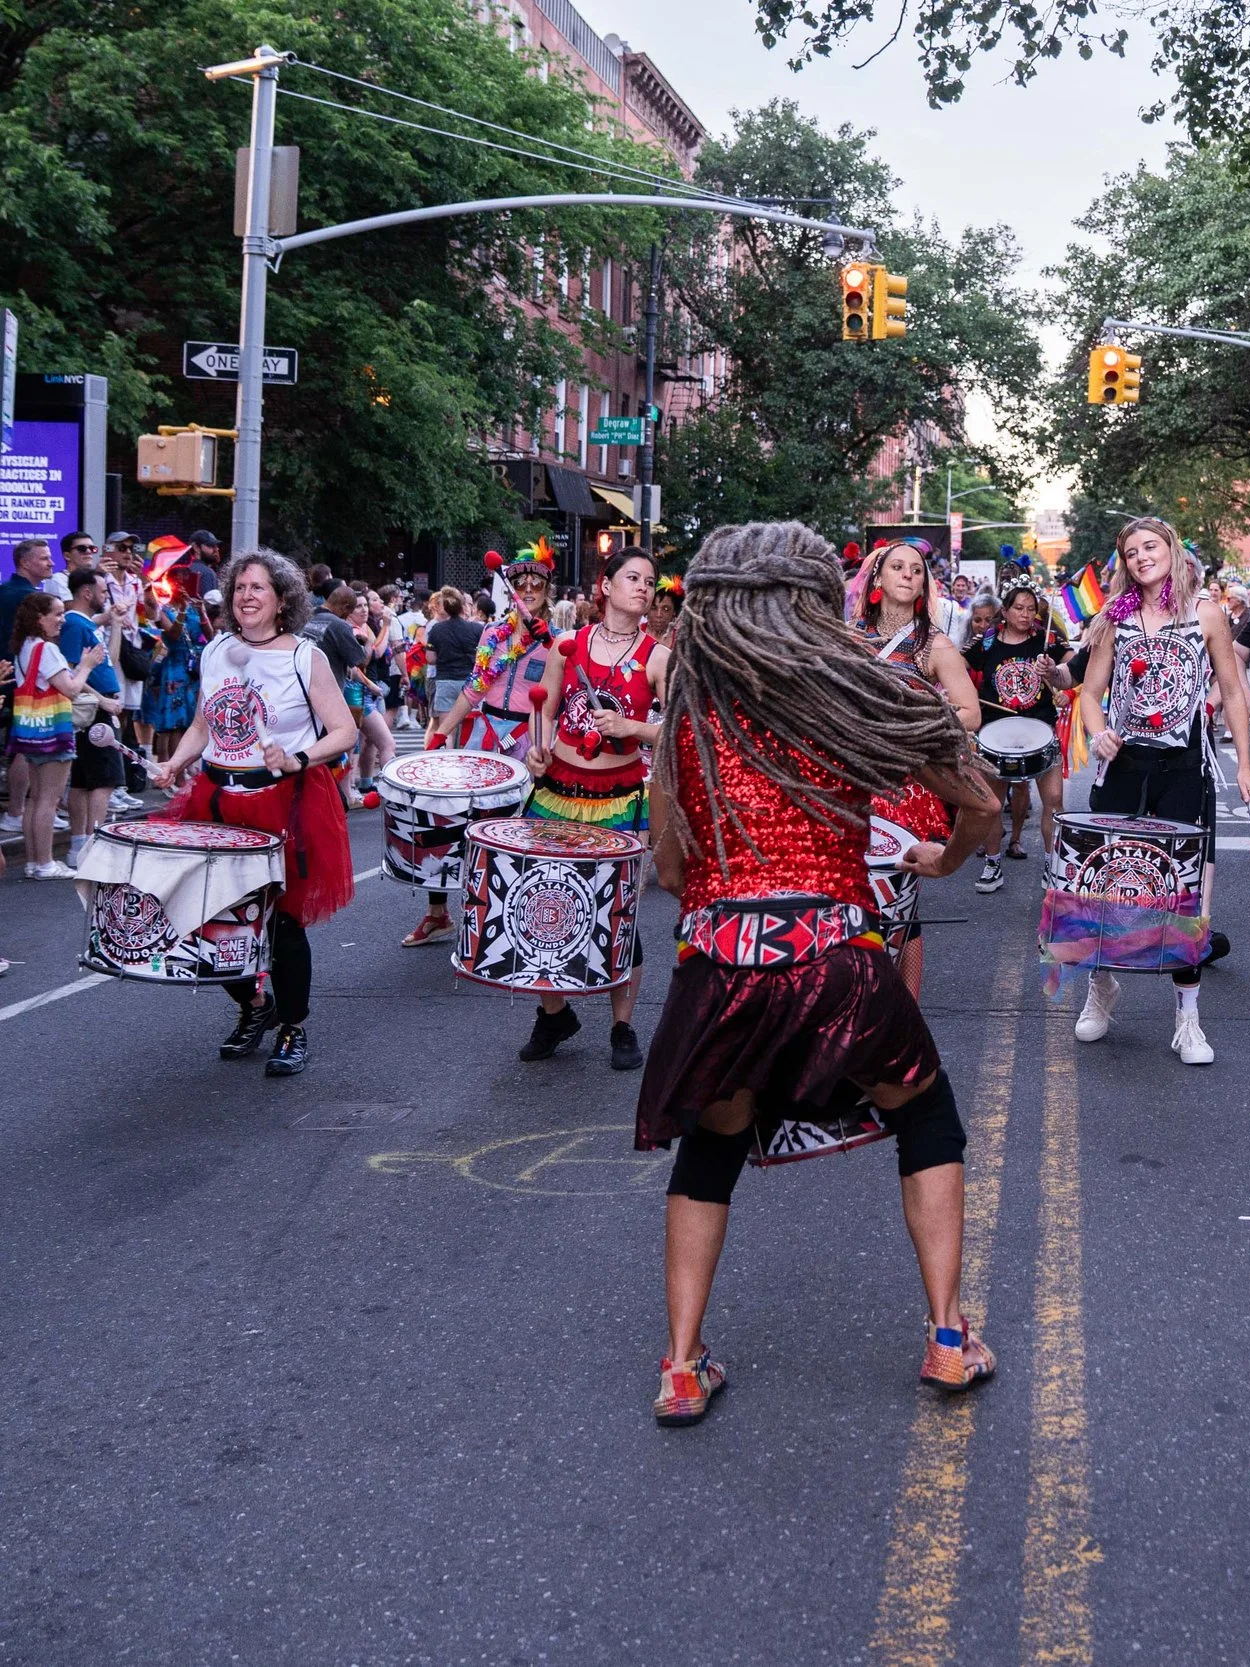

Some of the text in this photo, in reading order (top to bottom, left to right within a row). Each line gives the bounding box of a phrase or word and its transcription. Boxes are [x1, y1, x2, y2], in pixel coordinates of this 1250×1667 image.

[206, 355, 281, 371] ONE AY
[44, 374, 84, 384] LinkNYC
[603, 418, 630, 430] Degraw
[627, 432, 639, 440] Diaz
[49, 470, 62, 481] IN
[11, 499, 46, 508] RANKED
[49, 500, 61, 508] #1
[11, 510, 52, 521] QUALITY.
[1129, 642, 1180, 657] BATALA
[20, 714, 55, 728] MINT
[224, 750, 254, 762] YORK
[529, 881, 575, 898] BATALA
[220, 940, 245, 952] ONE
[529, 937, 567, 949] MUNDO
[107, 944, 150, 960] MUNDO
